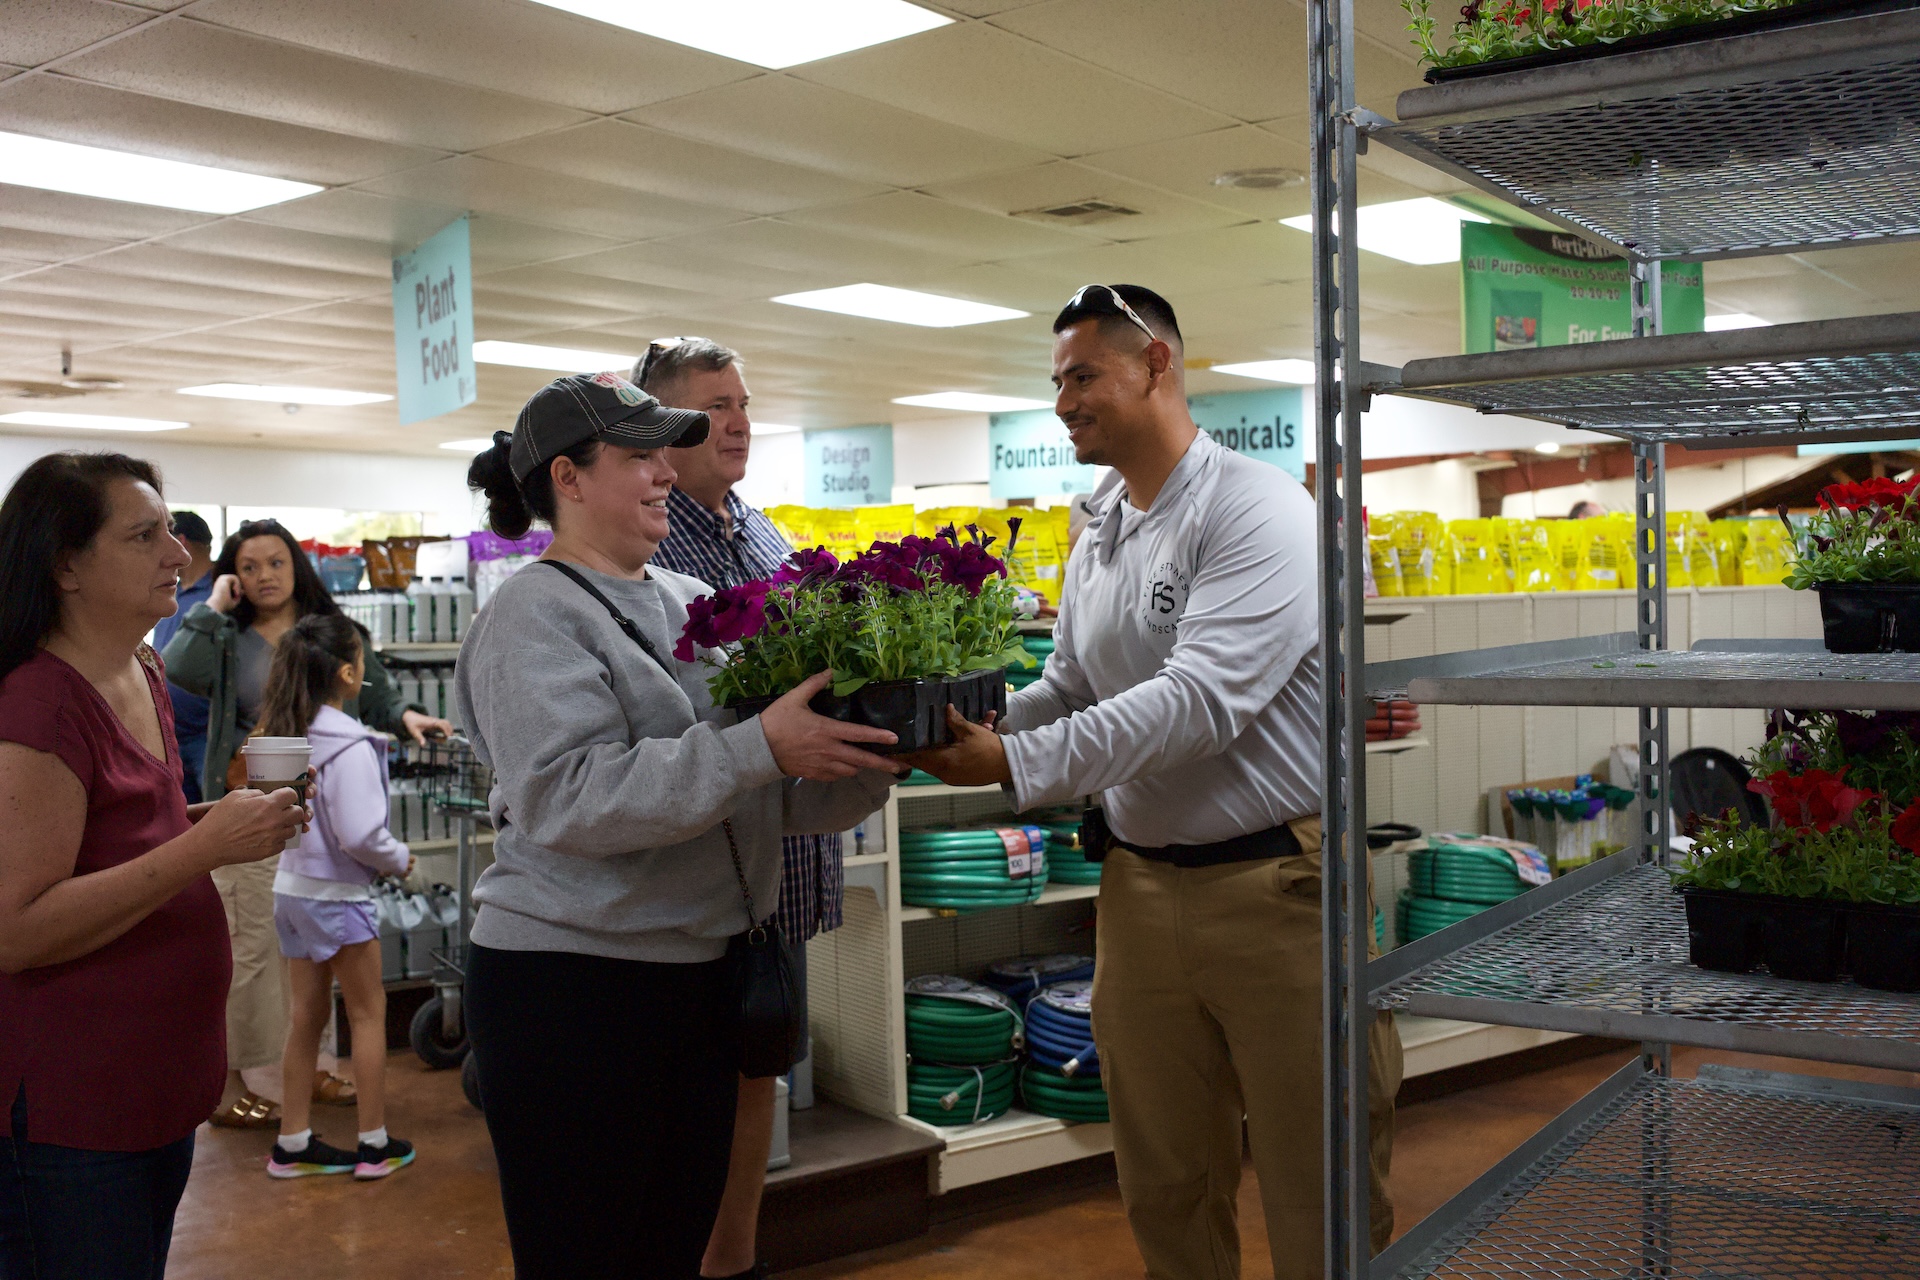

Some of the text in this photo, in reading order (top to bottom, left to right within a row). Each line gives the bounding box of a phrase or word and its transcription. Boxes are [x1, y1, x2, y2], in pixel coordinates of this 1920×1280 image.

[1467, 256, 1485, 272] All
[1491, 257, 1546, 277] Purpose
[415, 264, 457, 329] Plant
[1568, 324, 1598, 344] For
[421, 320, 458, 385] Food
[1196, 416, 1294, 452] opicals
[822, 442, 869, 470] Design
[995, 437, 1077, 471] Fountain
[823, 471, 869, 492] Studio
[1151, 581, 1175, 613] FS
